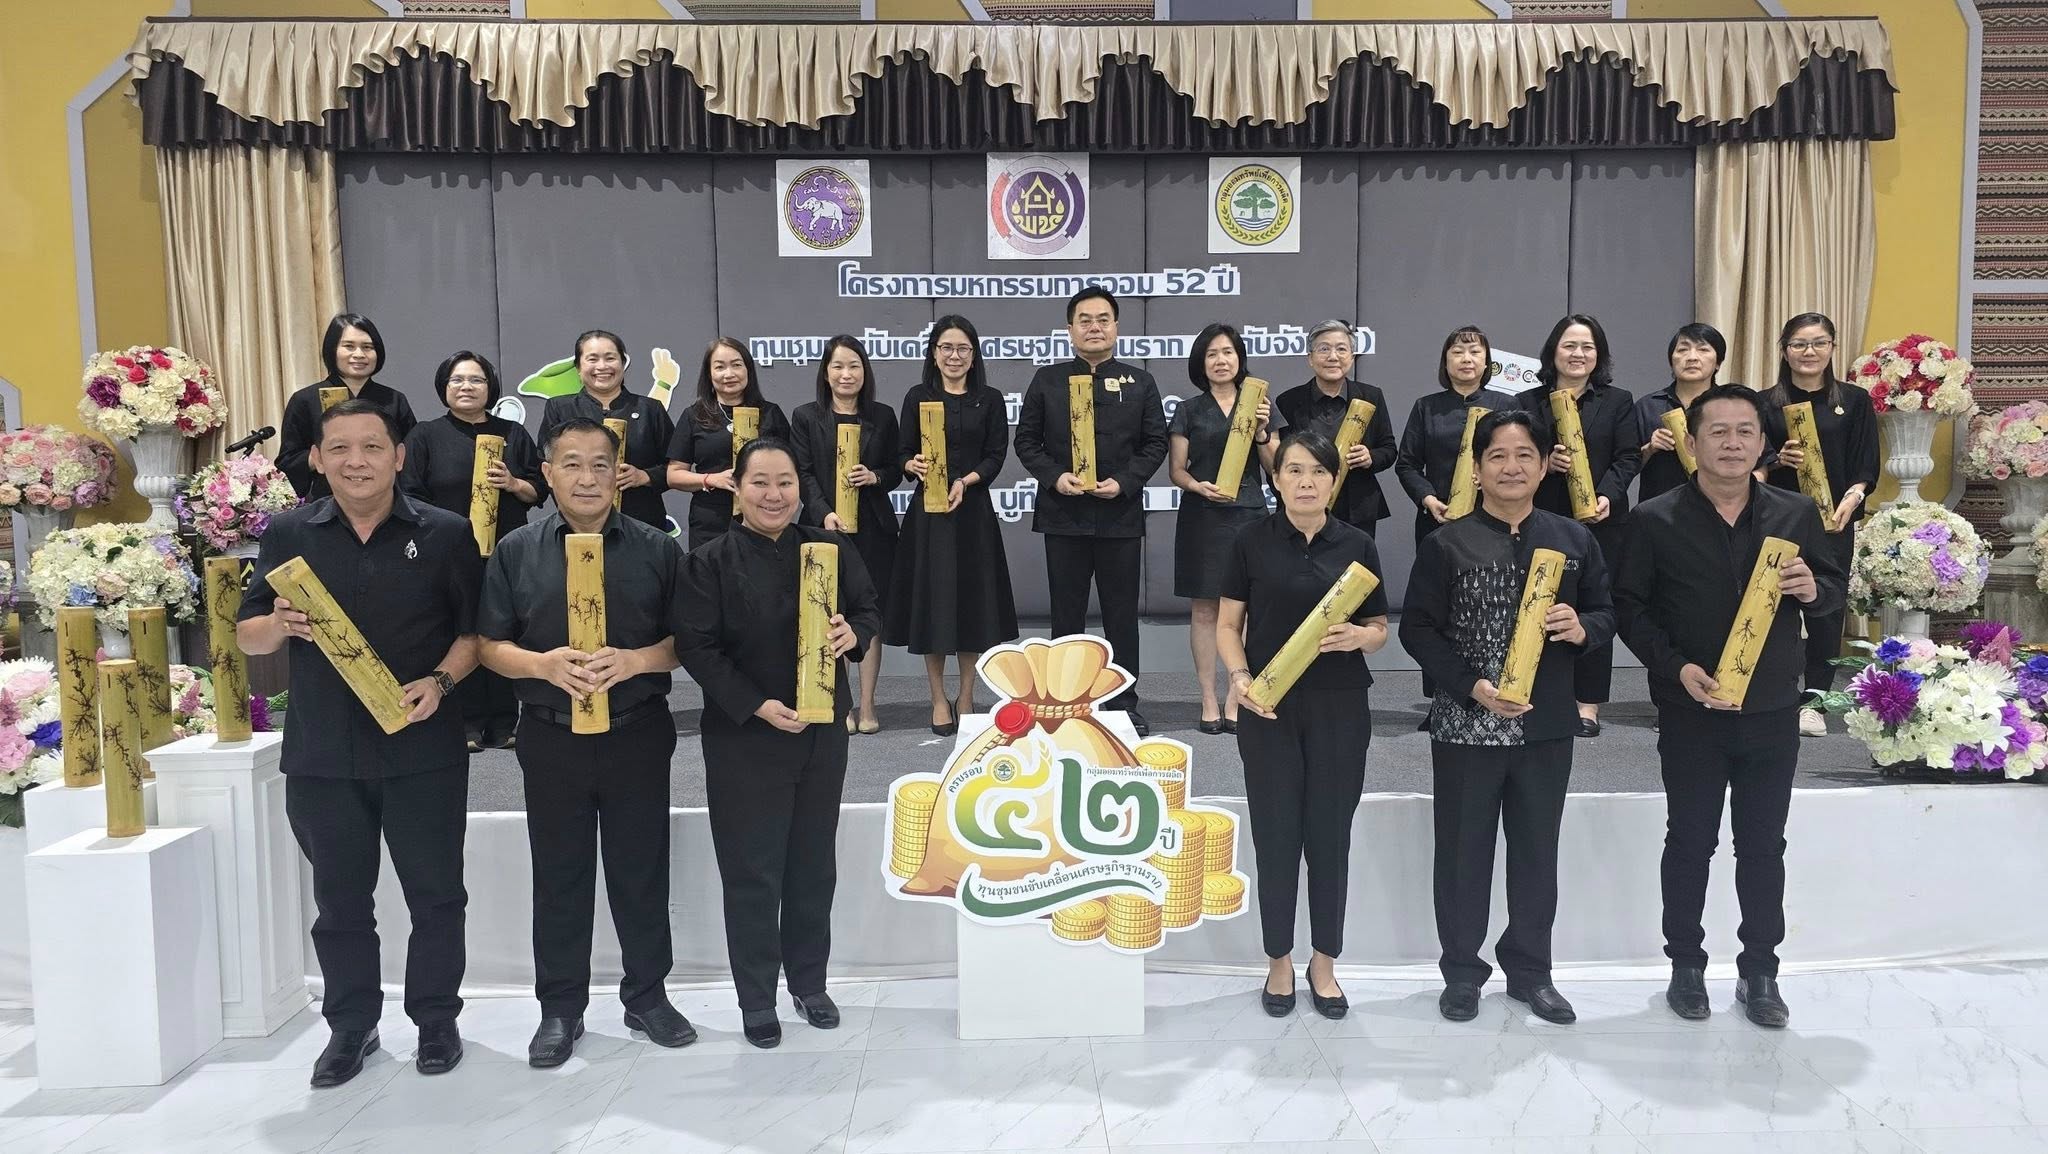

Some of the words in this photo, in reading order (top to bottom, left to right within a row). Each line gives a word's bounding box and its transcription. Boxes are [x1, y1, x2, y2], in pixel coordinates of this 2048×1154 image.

[1166, 272, 1206, 295] 52
[1211, 267, 1235, 294] ปี
[948, 766, 984, 793] ครบรอบ
[1159, 826, 1176, 850] ปี
[977, 860, 1163, 900] ทุนชุมชนขับเคลื่อนเศรษฐกิจฐานราก
